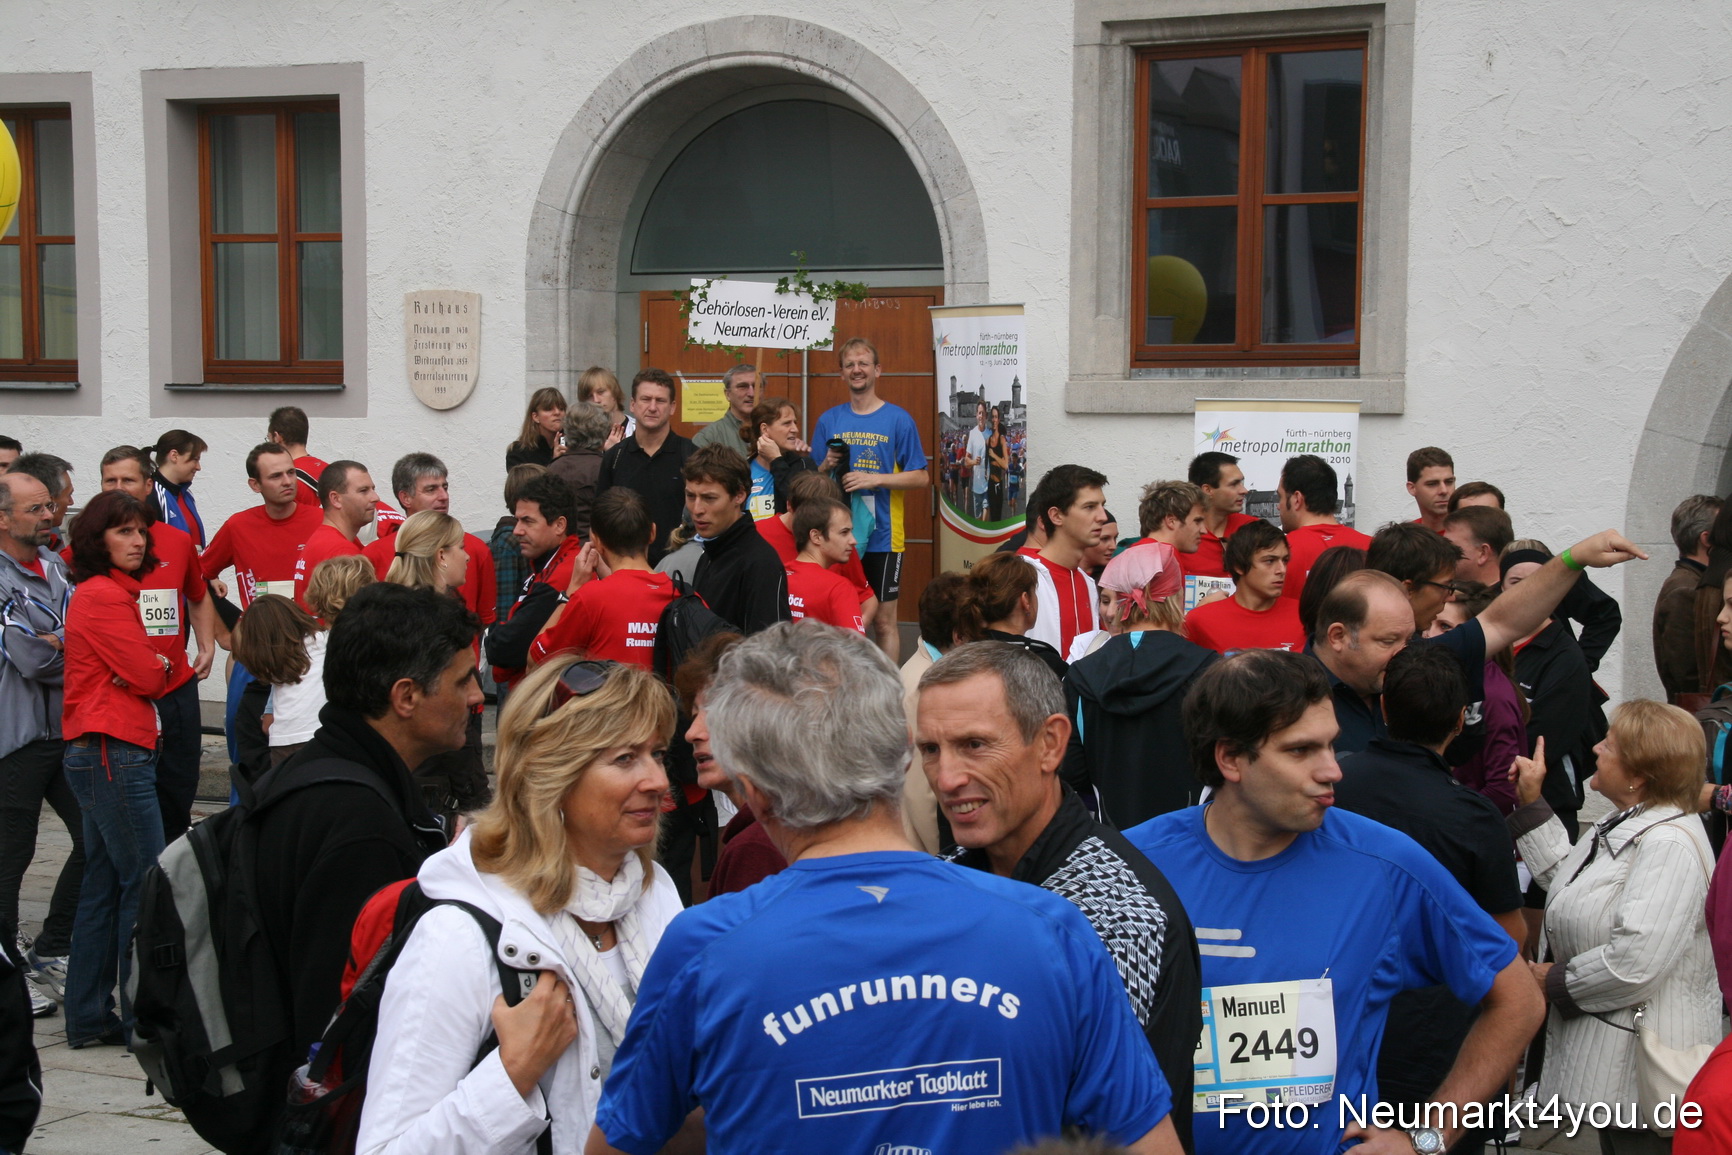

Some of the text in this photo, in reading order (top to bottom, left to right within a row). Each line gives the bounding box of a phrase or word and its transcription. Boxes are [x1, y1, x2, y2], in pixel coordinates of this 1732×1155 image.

[413, 301, 468, 315] Rathaus
[413, 323, 438, 334] Neubau
[942, 341, 1018, 359] metropolmarathon
[414, 355, 454, 367] Wiederaufbau
[1003, 358, 1018, 366] 2010
[413, 371, 468, 382] Generalsanierung
[434, 386, 447, 394] 1999
[842, 431, 889, 444] NEUMARKTER
[843, 438, 879, 447] TADTLAUF
[1219, 438, 1351, 456] metropolmarathon
[1330, 456, 1351, 464] 2010
[142, 593, 159, 603] Dirk
[145, 607, 176, 621] 5052
[627, 622, 659, 634] MAX
[762, 974, 1021, 1047] funrunners
[1221, 992, 1286, 1019] Manuel
[1228, 1027, 1319, 1064] 2449
[809, 1069, 989, 1108] Neumarkter Tagblatt
[1282, 1083, 1332, 1097] PFLEIDERER
[951, 1098, 1002, 1112] Hier lebe ich.
